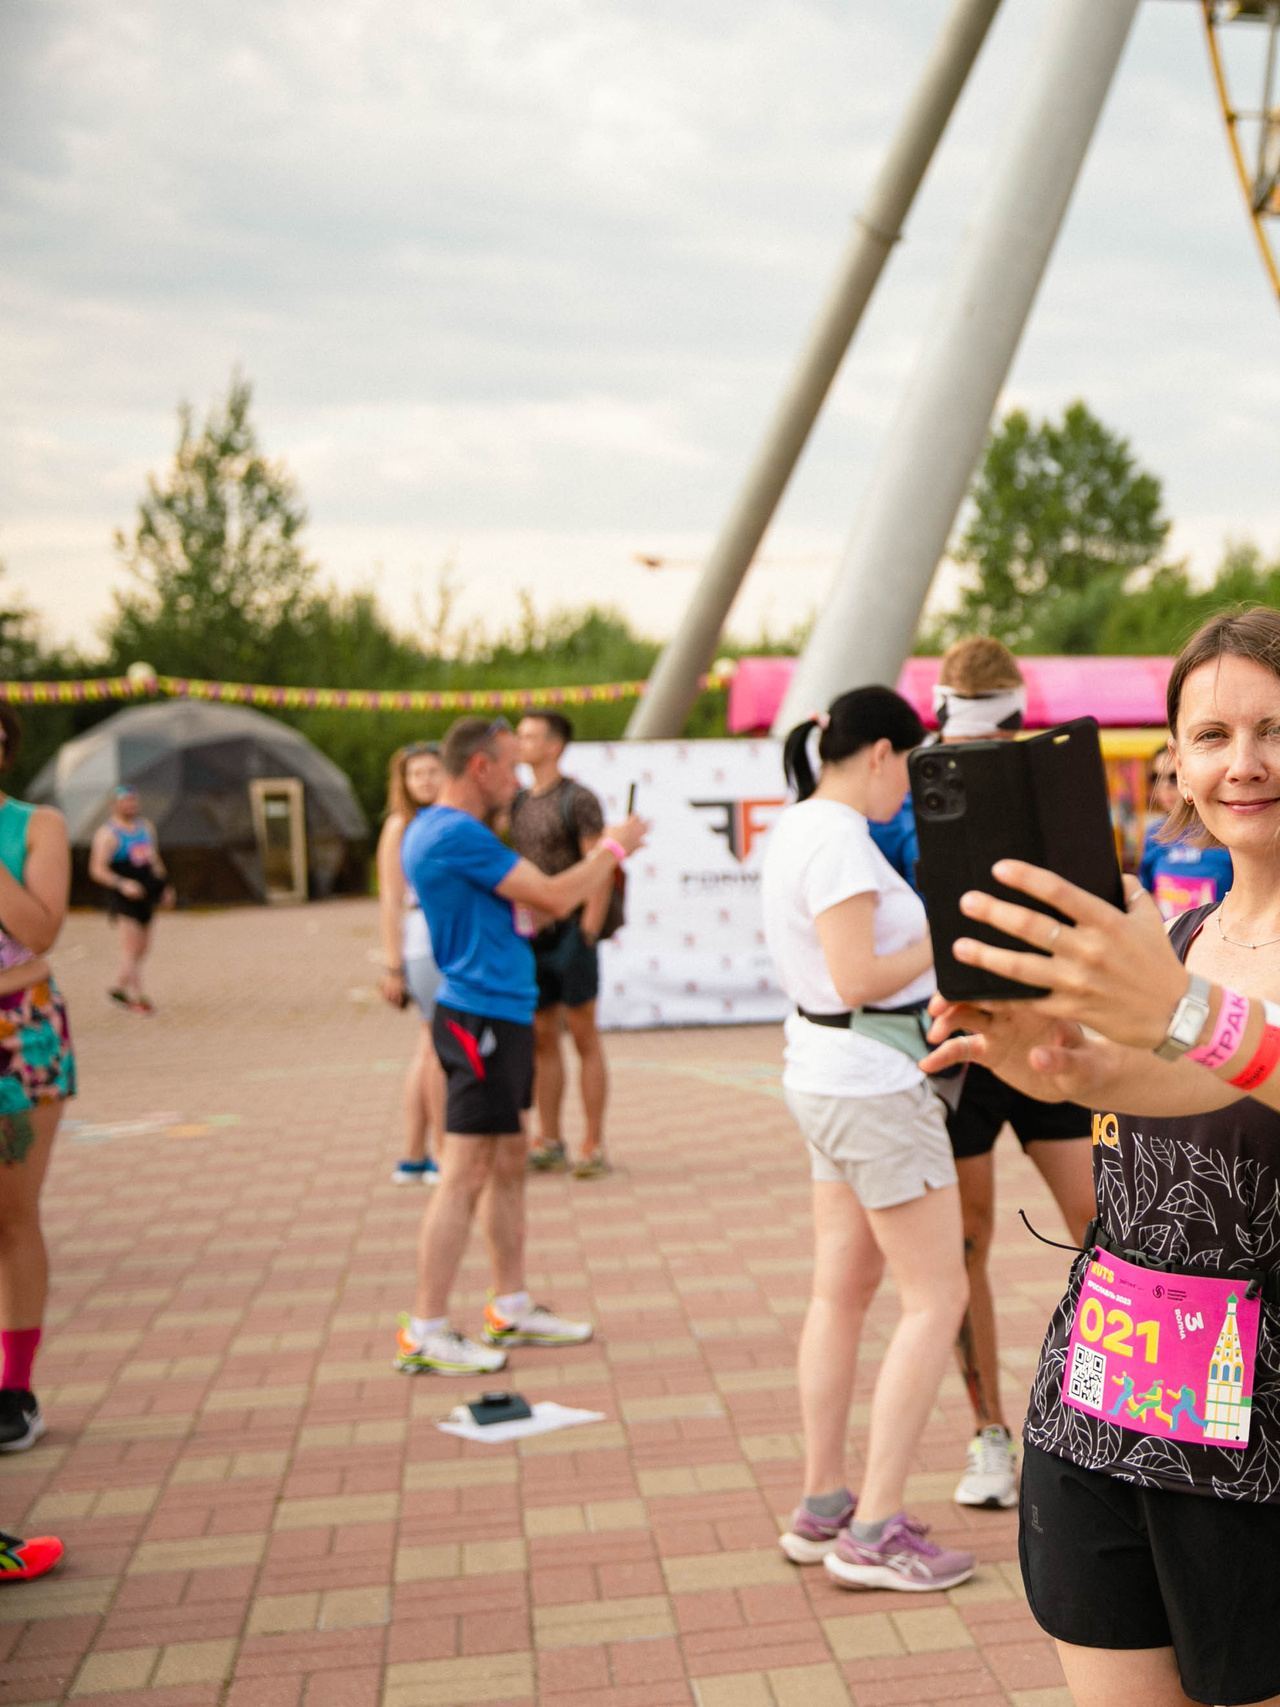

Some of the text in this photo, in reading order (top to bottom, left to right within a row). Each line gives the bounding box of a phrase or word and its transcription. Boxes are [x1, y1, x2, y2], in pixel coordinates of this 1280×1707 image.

[1091, 1261, 1115, 1283] RUTS
[1079, 1297, 1160, 1364] 021
[1174, 1308, 1186, 1340] ВОЛНА
[1184, 1312, 1205, 1332] 3
